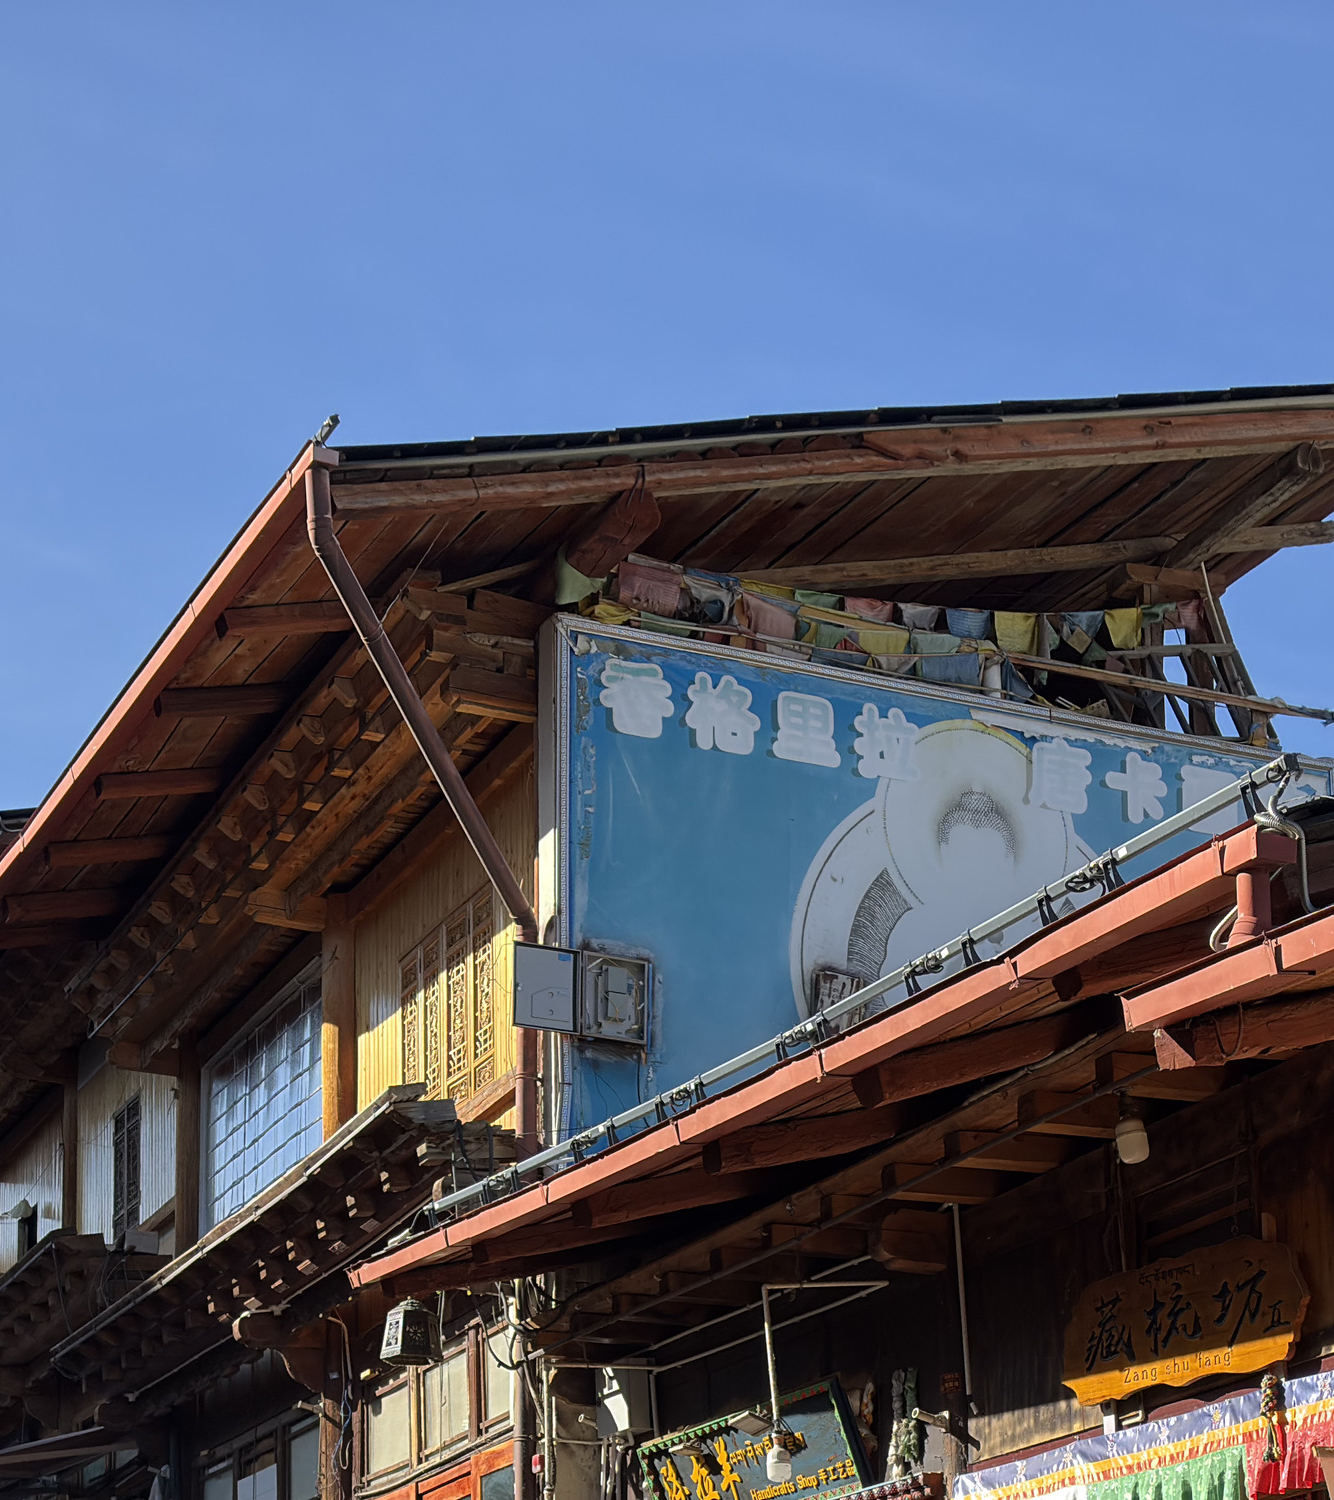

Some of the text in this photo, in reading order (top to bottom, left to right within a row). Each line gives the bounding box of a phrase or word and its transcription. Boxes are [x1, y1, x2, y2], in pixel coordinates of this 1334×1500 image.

[599, 658, 920, 782] 香格里拉
[1123, 1367, 1158, 1384] Zang
[1165, 1359, 1190, 1375] shu
[797, 1474, 818, 1490] Shop
[818, 1459, 855, 1484] 手工艺品
